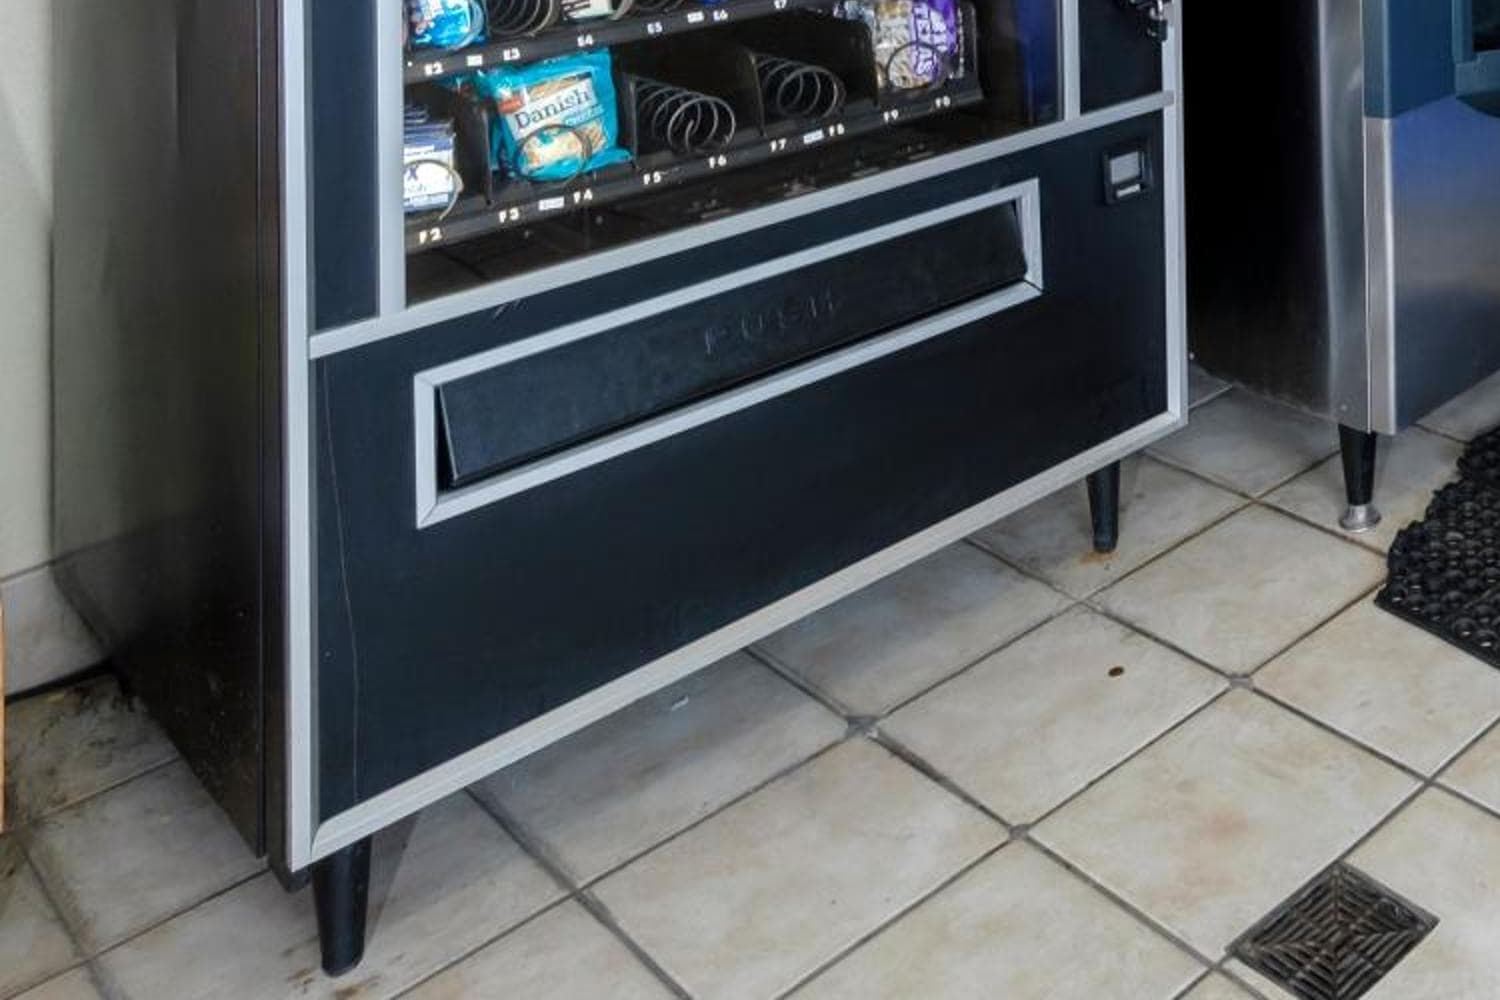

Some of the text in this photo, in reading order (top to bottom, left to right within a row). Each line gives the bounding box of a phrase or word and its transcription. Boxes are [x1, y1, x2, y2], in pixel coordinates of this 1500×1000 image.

[576, 33, 595, 48] E4
[502, 47, 521, 62] E3
[422, 60, 445, 77] E2
[514, 88, 595, 133] Danish
